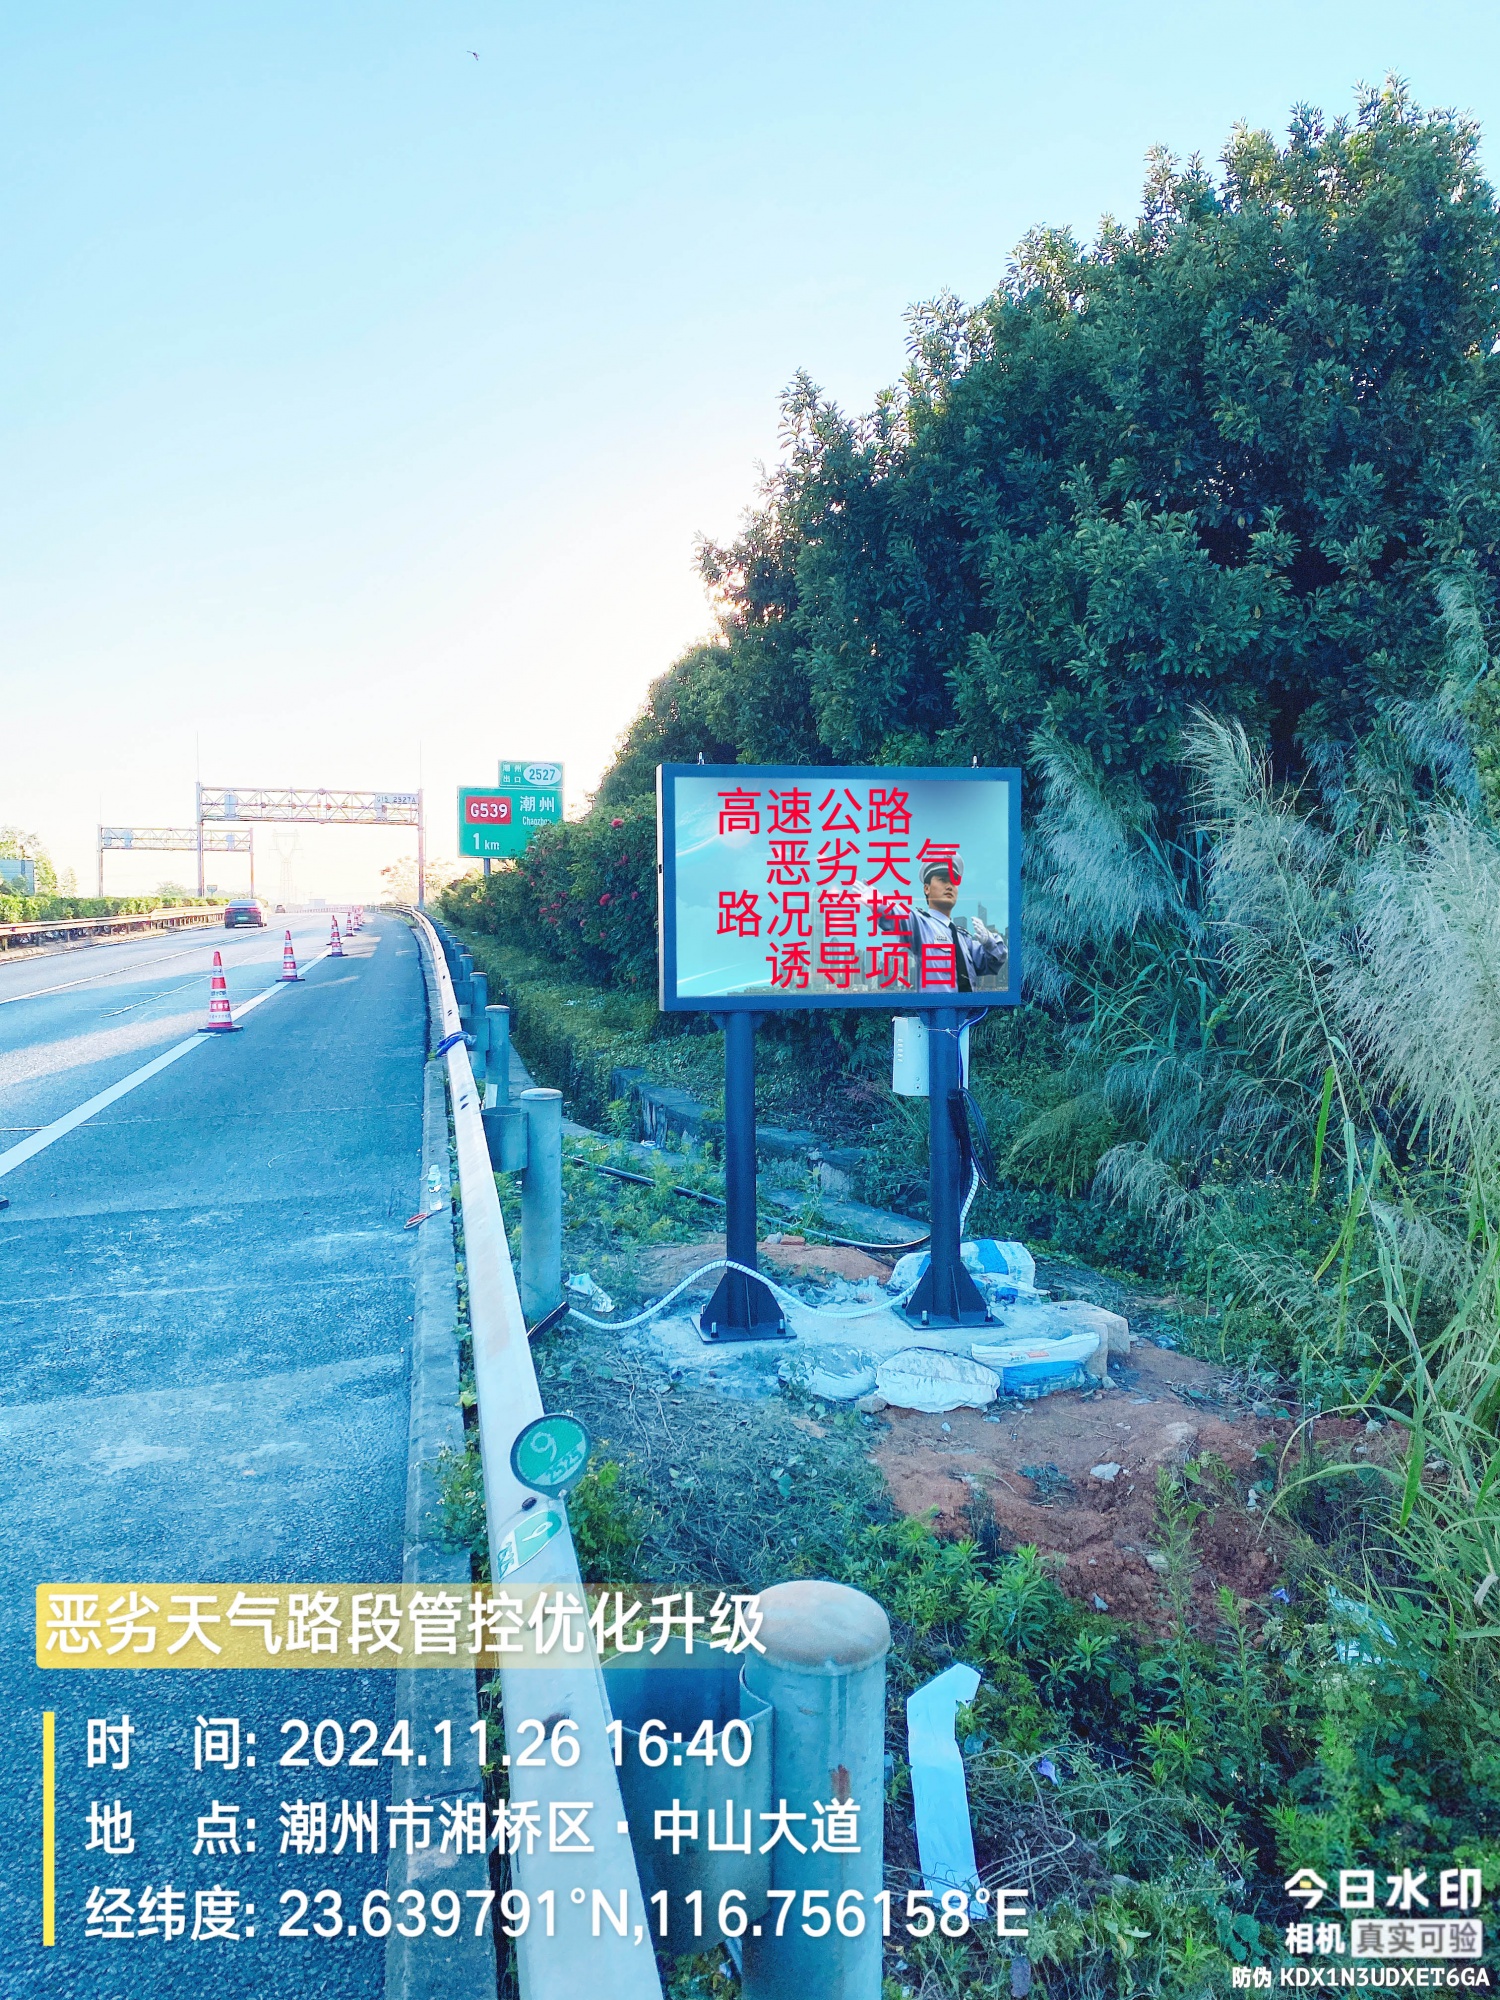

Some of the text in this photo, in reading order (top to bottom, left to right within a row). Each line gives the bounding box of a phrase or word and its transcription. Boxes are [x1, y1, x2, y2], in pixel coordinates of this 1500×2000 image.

[529, 768, 556, 781] 2527
[470, 802, 508, 818] G539
[519, 796, 555, 812] 潮州
[717, 787, 913, 835] 高速公路
[473, 832, 500, 850] 1 km
[766, 838, 962, 887] 恶劣天气
[716, 889, 913, 938] 路况管控
[765, 941, 957, 989] 诱导项目
[531, 1432, 557, 1463] 9
[546, 1449, 582, 1482] 2525
